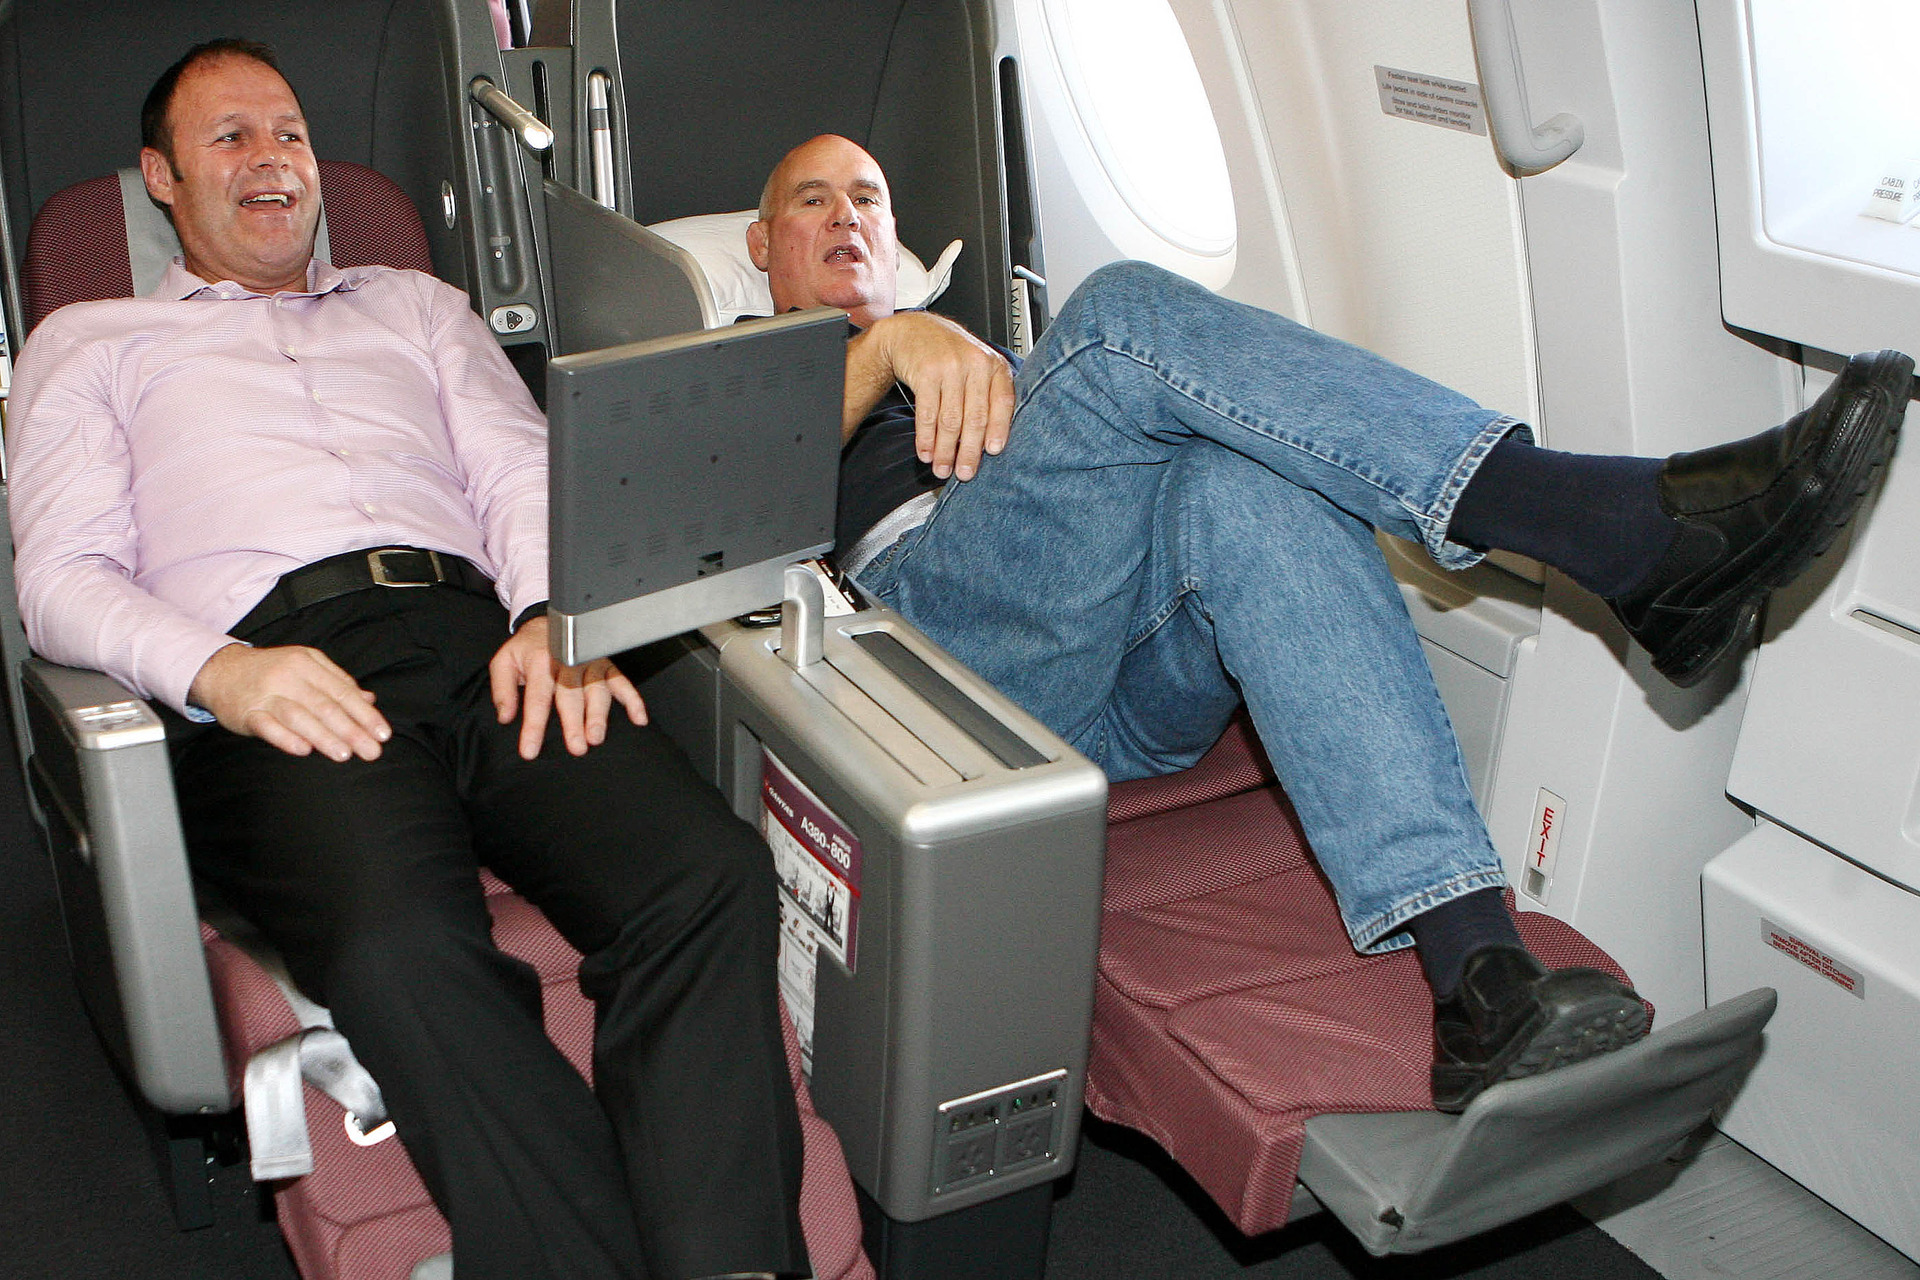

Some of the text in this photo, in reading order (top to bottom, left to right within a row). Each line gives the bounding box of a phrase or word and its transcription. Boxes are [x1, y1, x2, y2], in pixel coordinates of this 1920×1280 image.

[1872, 188, 1905, 202] PRESSURE
[1881, 176, 1905, 188] CABIN
[800, 816, 851, 870] A380-800
[1536, 806, 1555, 868] EXIT
[1770, 931, 1799, 952] REMOVE
[1799, 948, 1822, 966] AFTER
[1772, 939, 1854, 991] BEFORE DOOR OPENING
[1788, 935, 1834, 966] SURVIVAL KIT
